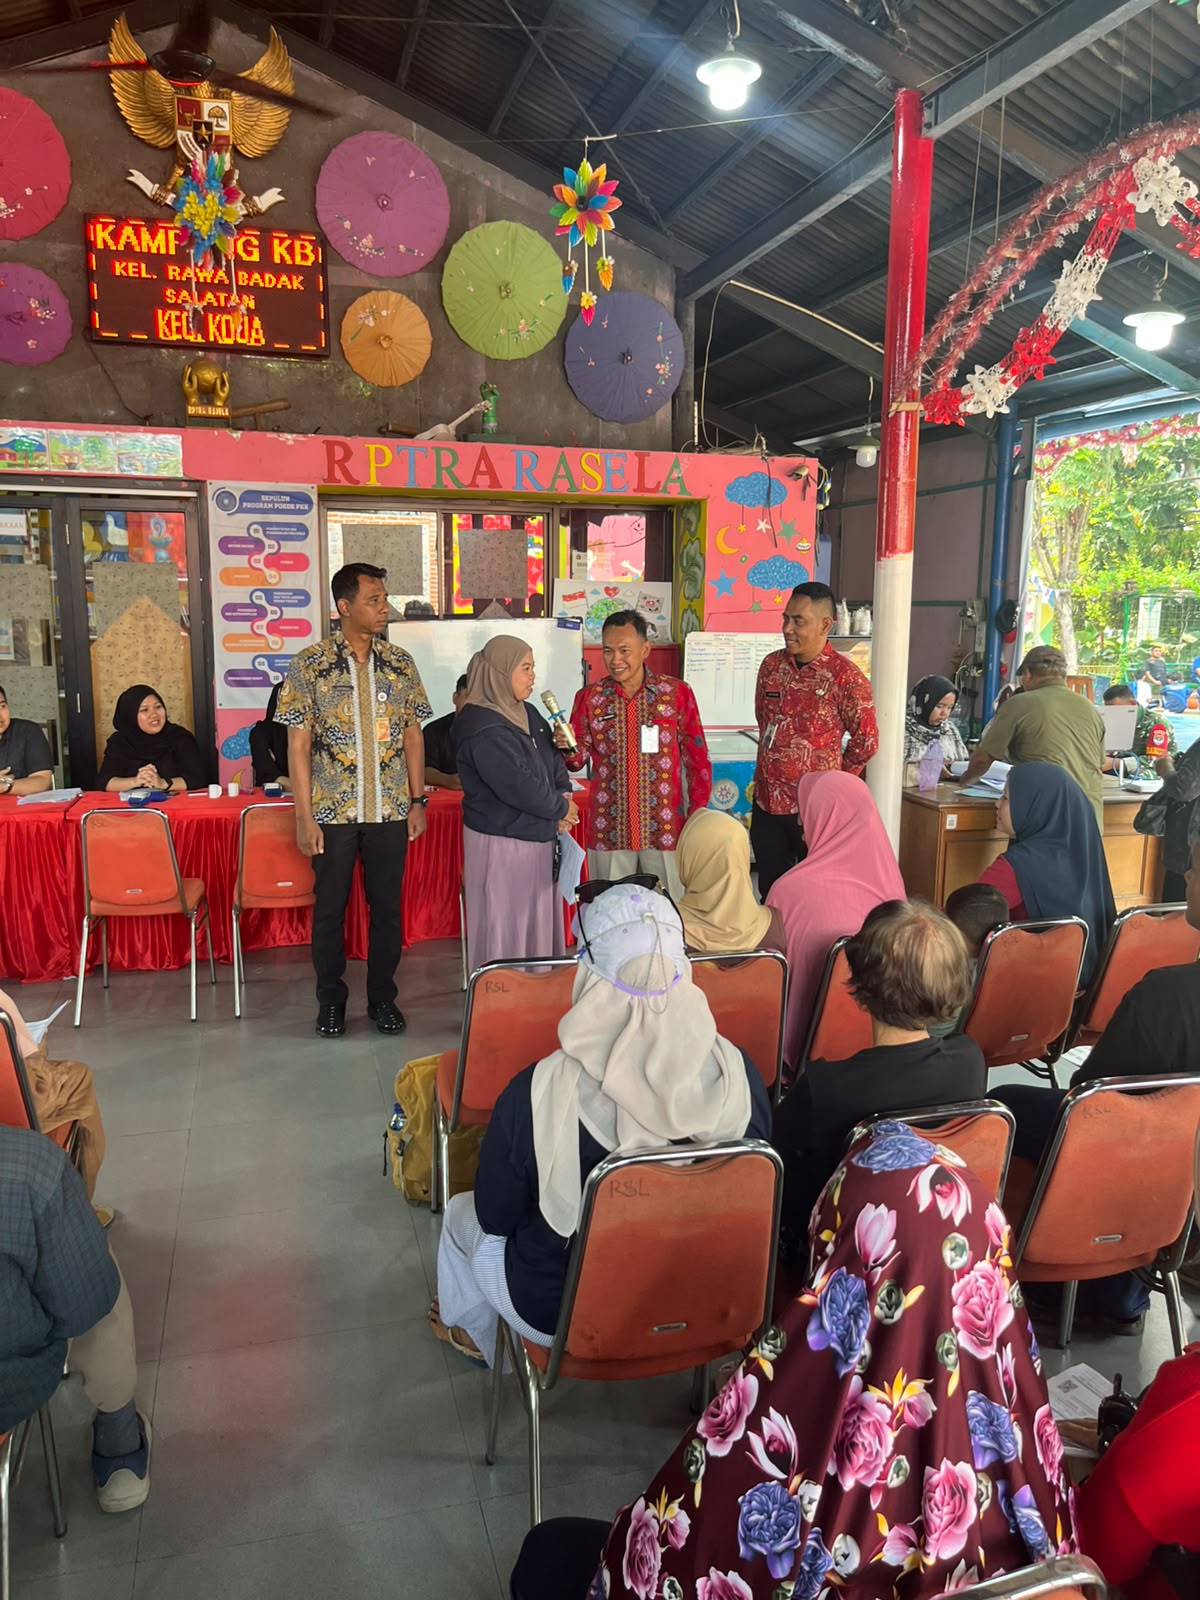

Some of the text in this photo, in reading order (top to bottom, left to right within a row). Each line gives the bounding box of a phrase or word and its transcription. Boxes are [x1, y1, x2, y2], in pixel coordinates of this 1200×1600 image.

[94, 223, 316, 267] KAMPG KB
[113, 260, 304, 291] KEL. RAWA BADAK
[322, 440, 692, 497] RPTRA RASELA
[485, 980, 511, 993] RSL
[609, 1176, 650, 1199] RSL
